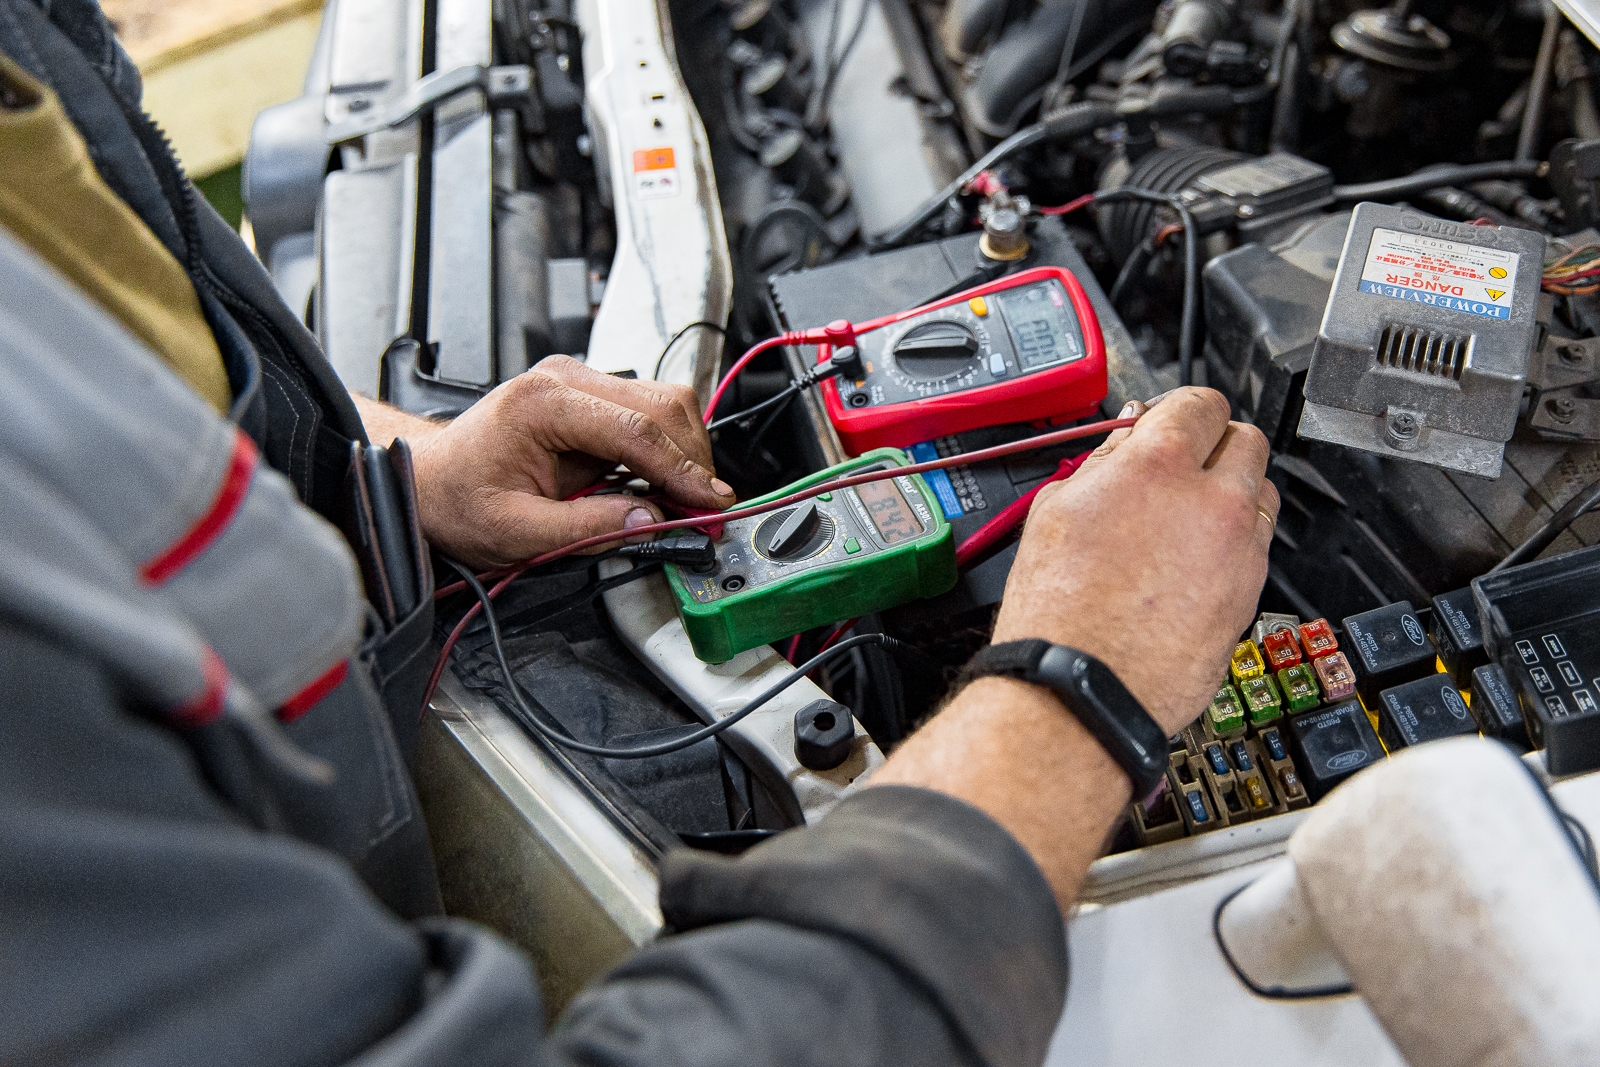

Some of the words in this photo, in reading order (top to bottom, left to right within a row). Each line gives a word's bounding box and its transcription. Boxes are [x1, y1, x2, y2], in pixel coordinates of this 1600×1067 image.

[1386, 273, 1464, 297] DANGER
[1367, 283, 1501, 318] POWERVIEW
[1270, 737, 1282, 749] 15
[1212, 751, 1224, 763] 15
[1237, 749, 1248, 761] 15
[1191, 799, 1202, 811] 15
